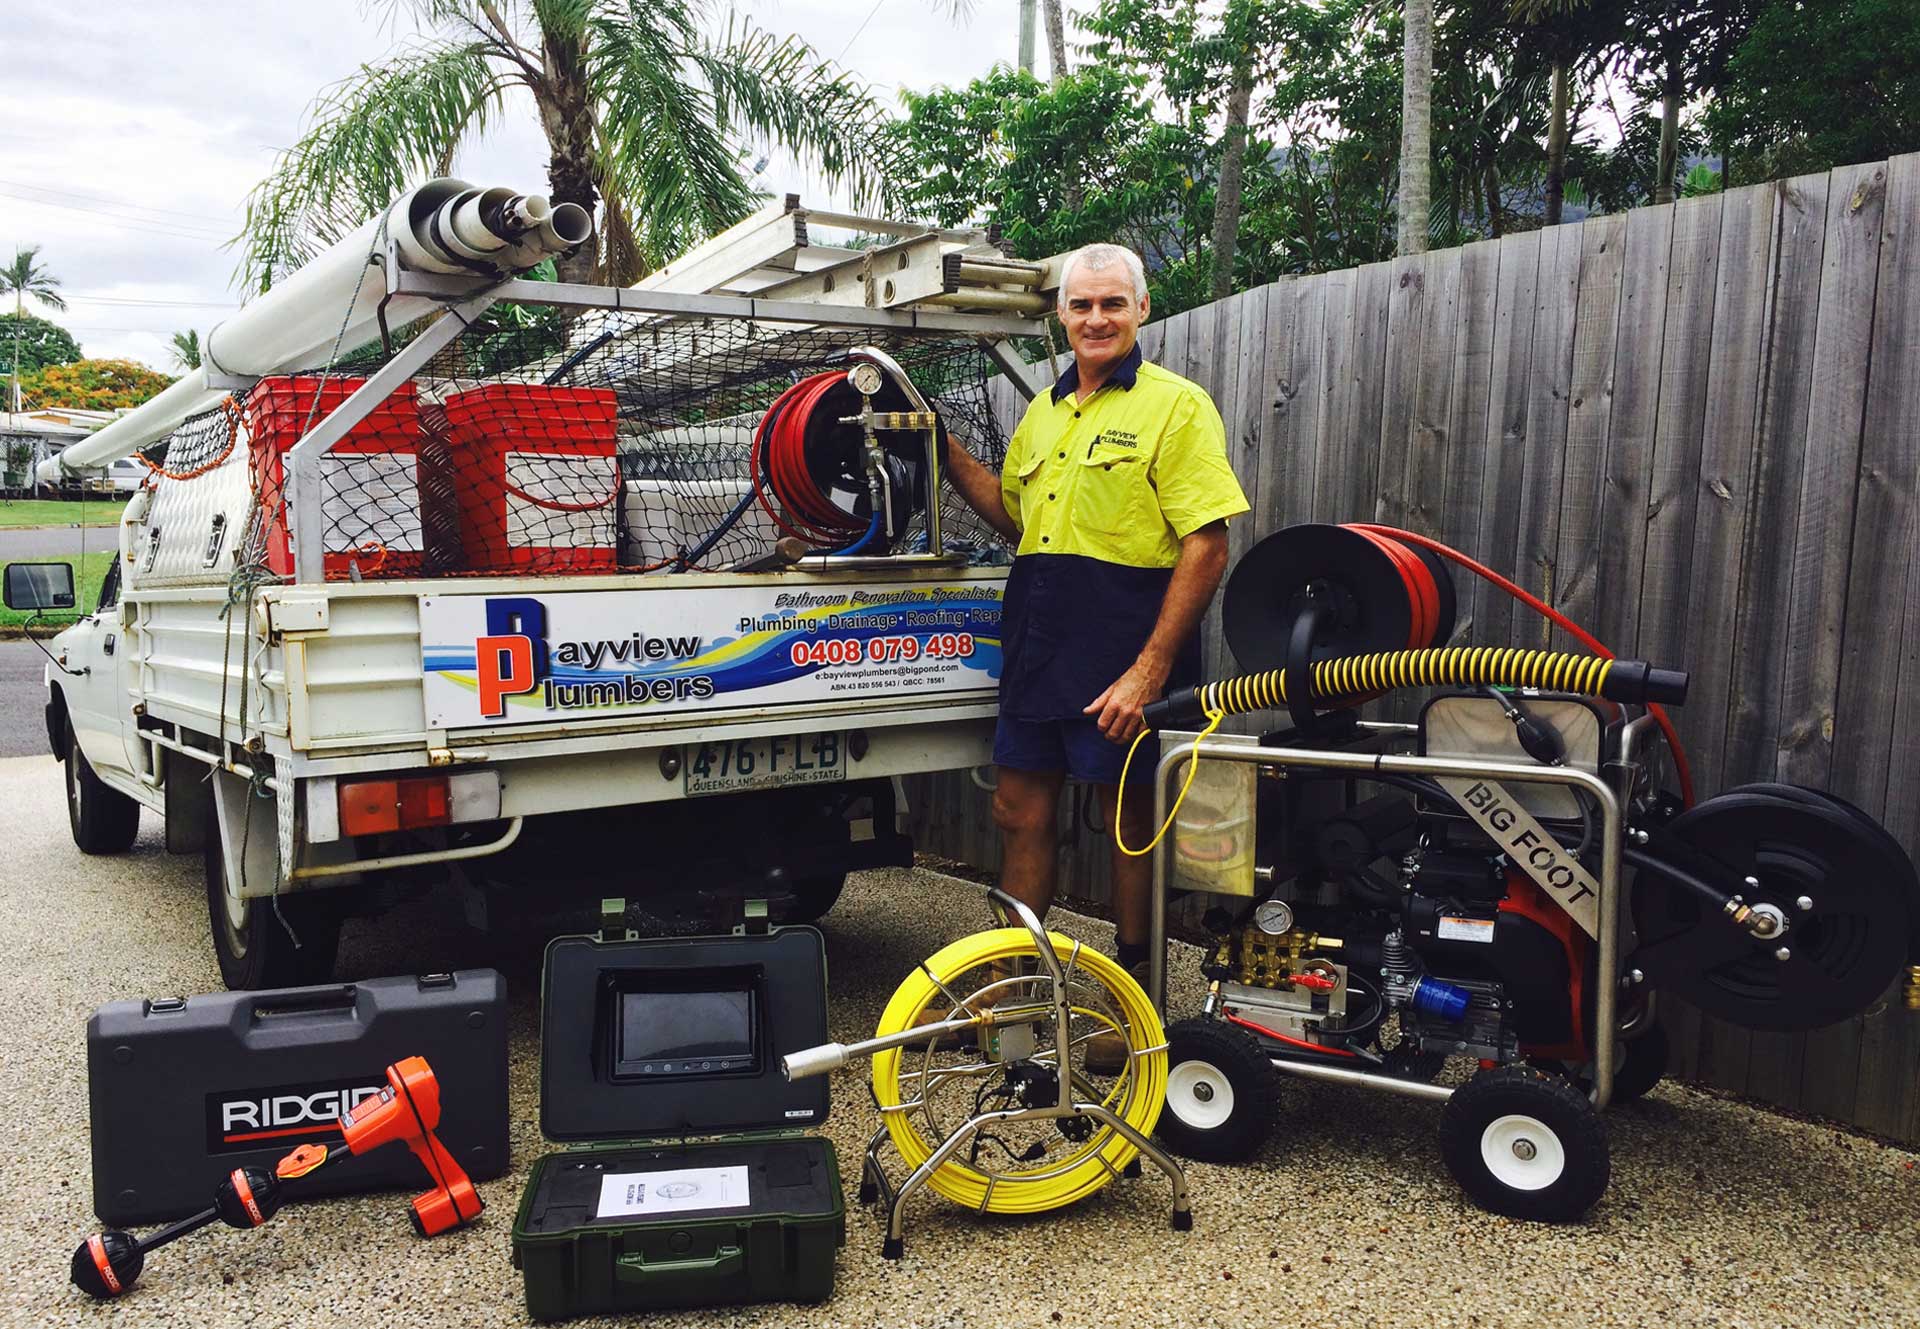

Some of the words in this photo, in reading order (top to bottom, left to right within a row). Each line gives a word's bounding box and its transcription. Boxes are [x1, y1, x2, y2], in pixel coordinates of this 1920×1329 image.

[775, 591, 847, 608] Bathroom
[850, 589, 926, 606] Renovation
[931, 585, 998, 605] Specialists
[740, 615, 817, 633] Plumbing
[828, 613, 896, 631] Drainage
[907, 610, 964, 627] Roofing
[971, 607, 1003, 625] Rep
[791, 639, 860, 667] 0408
[869, 636, 920, 663] 079
[926, 633, 974, 658] 498
[1463, 782, 1516, 832] BIG
[1511, 829, 1595, 904] FOOT
